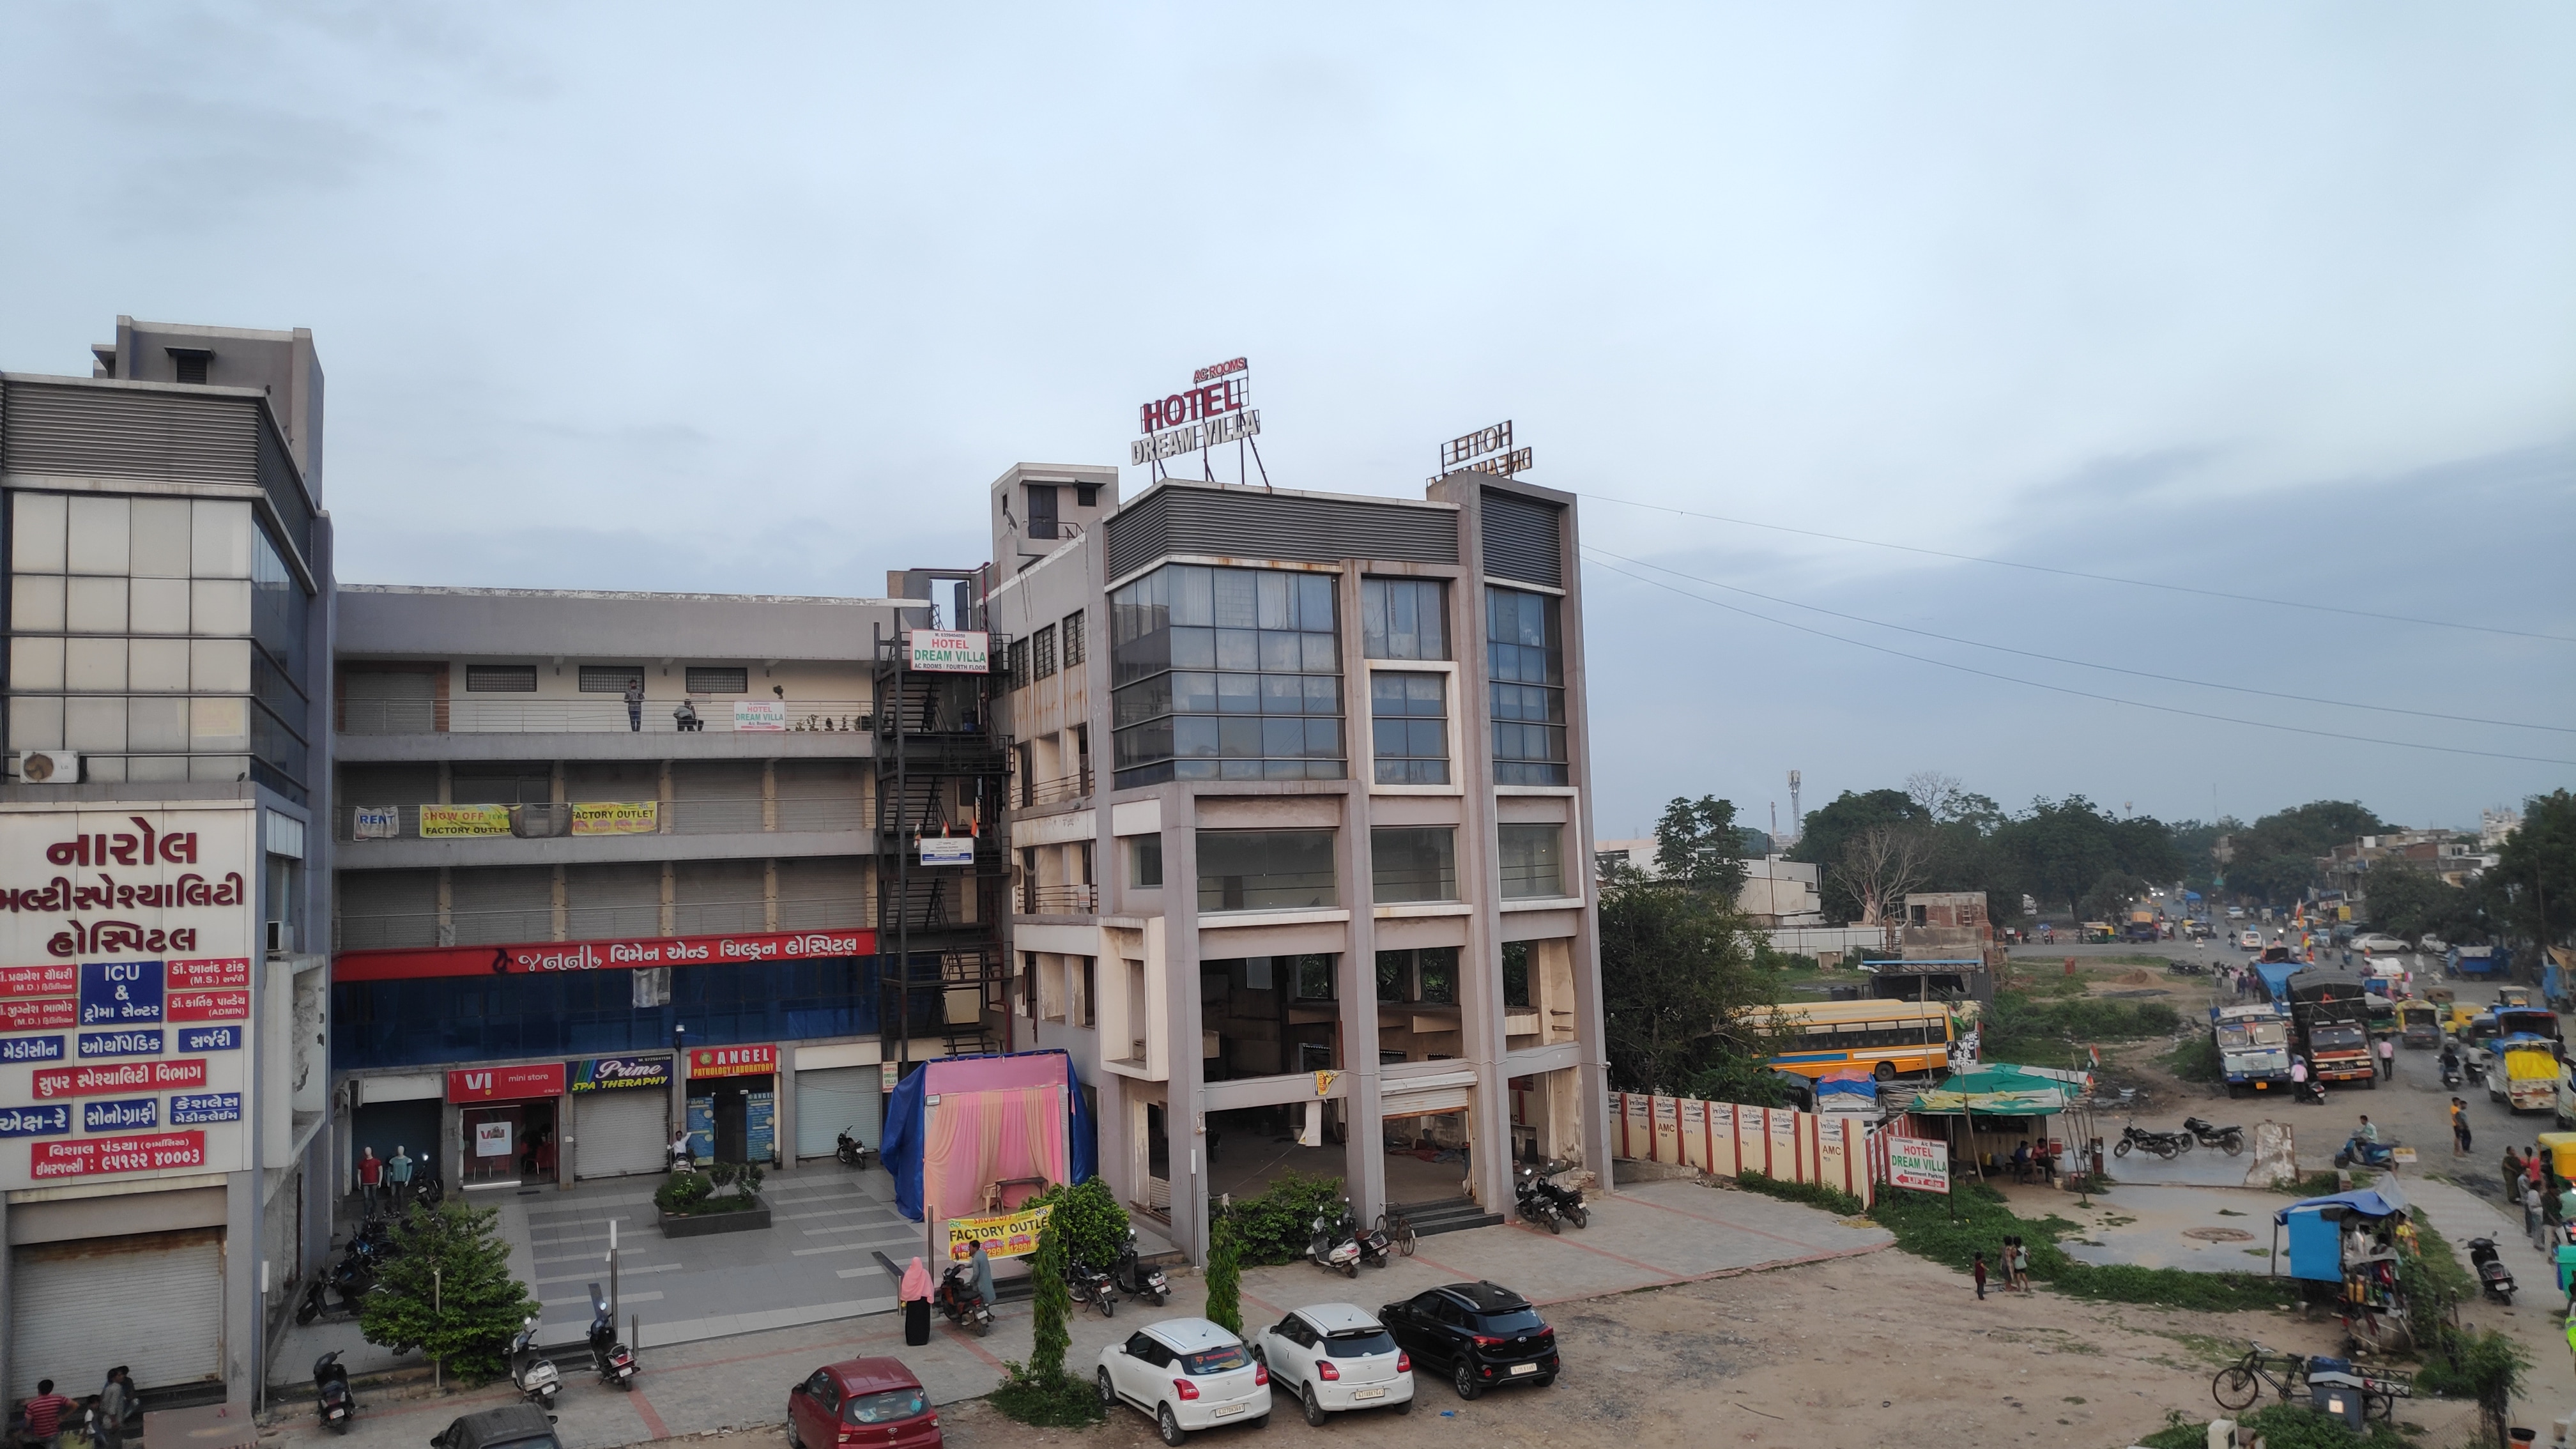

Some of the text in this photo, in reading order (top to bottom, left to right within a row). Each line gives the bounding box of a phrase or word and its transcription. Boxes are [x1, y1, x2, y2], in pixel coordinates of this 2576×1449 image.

[1193, 356, 1246, 384] AC ROOMS
[1143, 379, 1243, 433] HOTEL
[1131, 410, 1260, 466] DREAM VILLA
[931, 639, 969, 649] HOTEL
[914, 649, 986, 663] DREAM VILLA
[360, 815, 395, 825] RENT
[424, 812, 458, 821] SHOW
[462, 812, 484, 821] OFF
[617, 809, 654, 818] OUTLET
[47, 816, 197, 866] નારોલ
[47, 919, 196, 957] હોસ્પિટલ
[610, 943, 659, 963] વિમેન
[666, 941, 709, 960] એન્ડ
[785, 935, 857, 956] હોસ્પિટલ
[105, 965, 140, 981] ICU
[190, 975, 219, 986] (M.S.)
[115, 985, 130, 1001] &
[84, 1002, 160, 1023] ટ્રોમા સેન્ટર
[208, 1008, 245, 1018] (ADMIN)
[190, 1029, 231, 1048] સર્જરી
[1964, 1032, 1978, 1041] AMC
[3, 1039, 58, 1059] મેડીસીન
[717, 1048, 769, 1065] ANGEL
[595, 1060, 663, 1078] Prime
[732, 1063, 774, 1074] LABORATORY
[39, 1075, 70, 1096] સુપર
[156, 1063, 201, 1082] વિભાગ
[508, 1074, 526, 1082] mini
[572, 1081, 596, 1091] SPA
[601, 1076, 668, 1089] THERAPHY
[175, 1095, 238, 1110] કેશલેસ
[86, 1101, 157, 1126] સોનોગ્રાફી
[1658, 1123, 1675, 1133] AMC
[49, 1144, 94, 1158] વિશાલ
[1822, 1145, 1841, 1156] AMC
[1903, 1145, 1933, 1158] HOTEL
[102, 1153, 148, 1170] ૯૫૧૨૨
[155, 1149, 200, 1166] ૪૦૦૦૩
[1891, 1154, 1947, 1173] DREAM VILLA
[1903, 1169, 1945, 1181] Basement Parking
[1908, 1177, 1924, 1185] LIFT
[974, 1216, 996, 1225] SHOW
[949, 1225, 1005, 1242] FACTORY
[1009, 1216, 1048, 1234] OUTLE
